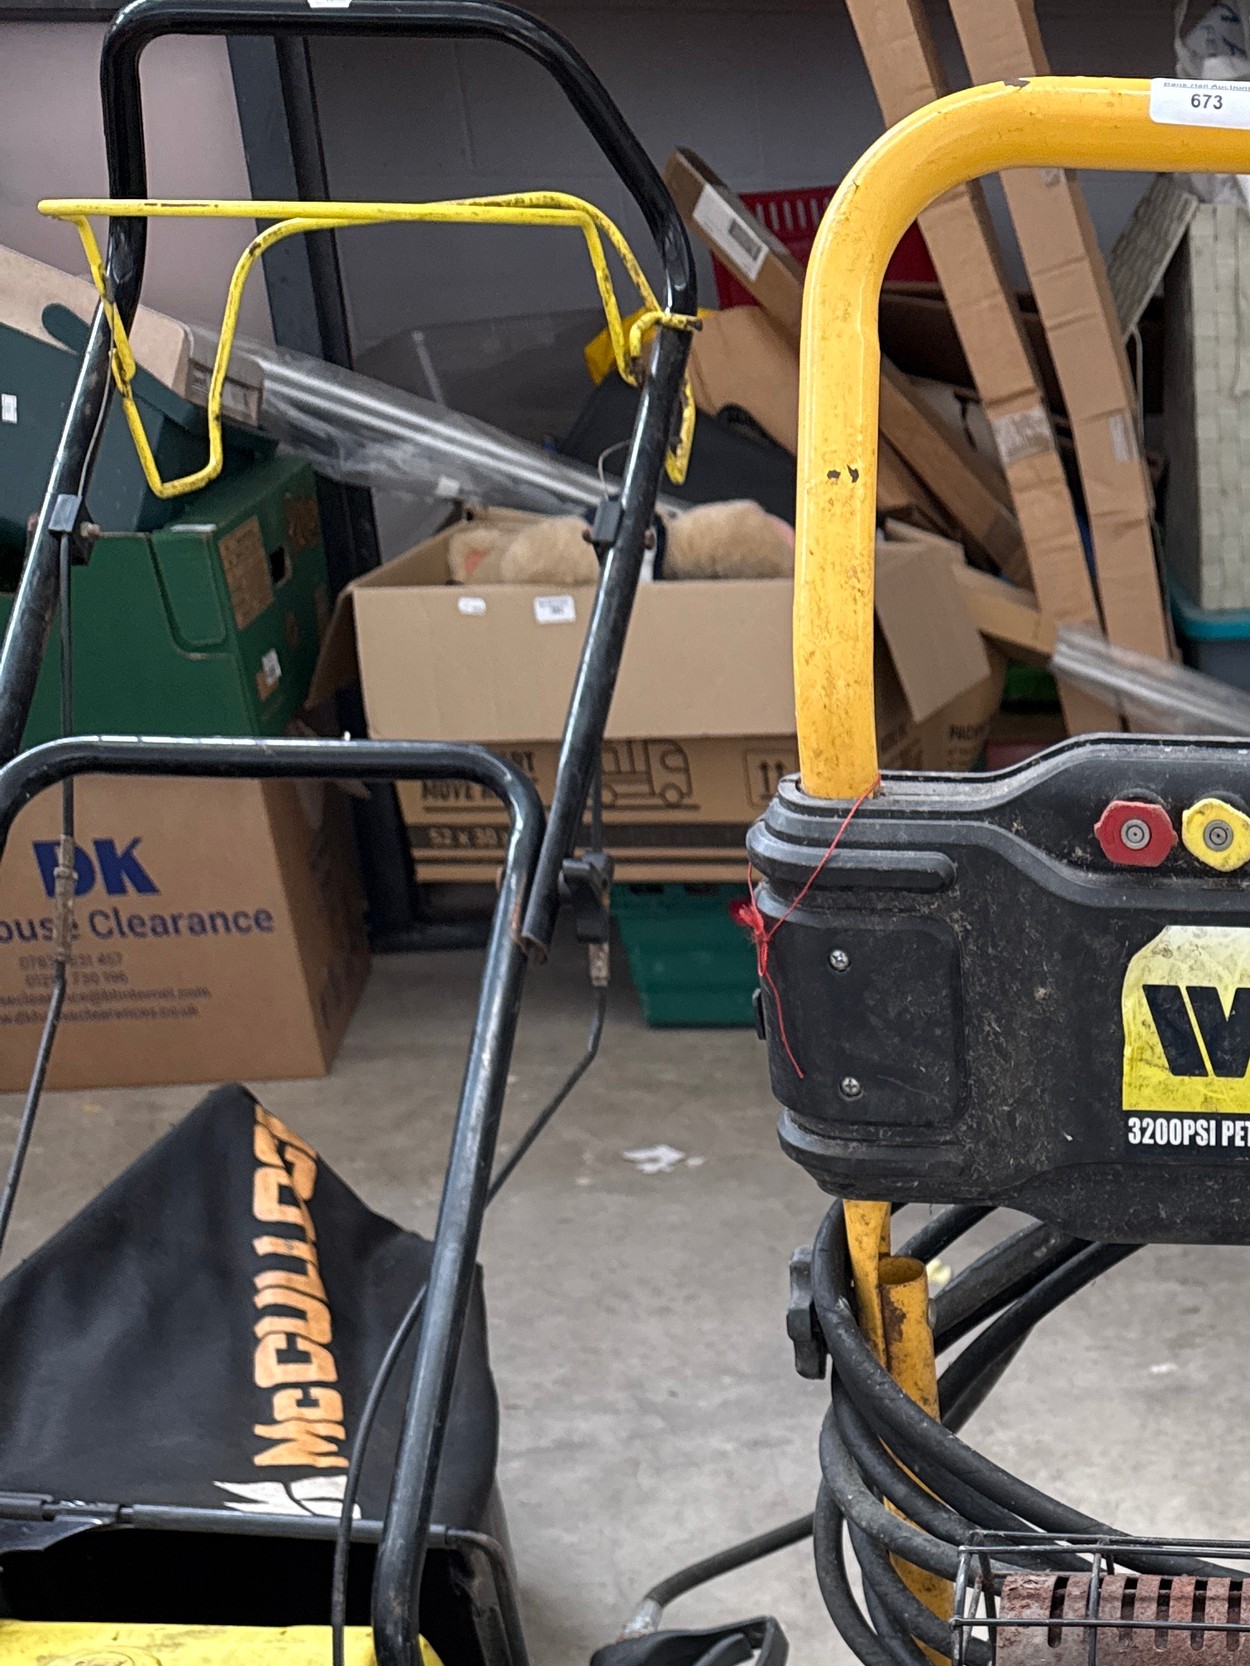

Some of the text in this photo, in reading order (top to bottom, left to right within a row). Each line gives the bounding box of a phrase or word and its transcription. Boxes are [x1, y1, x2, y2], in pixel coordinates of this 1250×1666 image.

[1191, 94, 1223, 109] 673
[32, 837, 162, 898] DK
[88, 906, 275, 940] Clearance
[1128, 1117, 1217, 1147] 3200PSI
